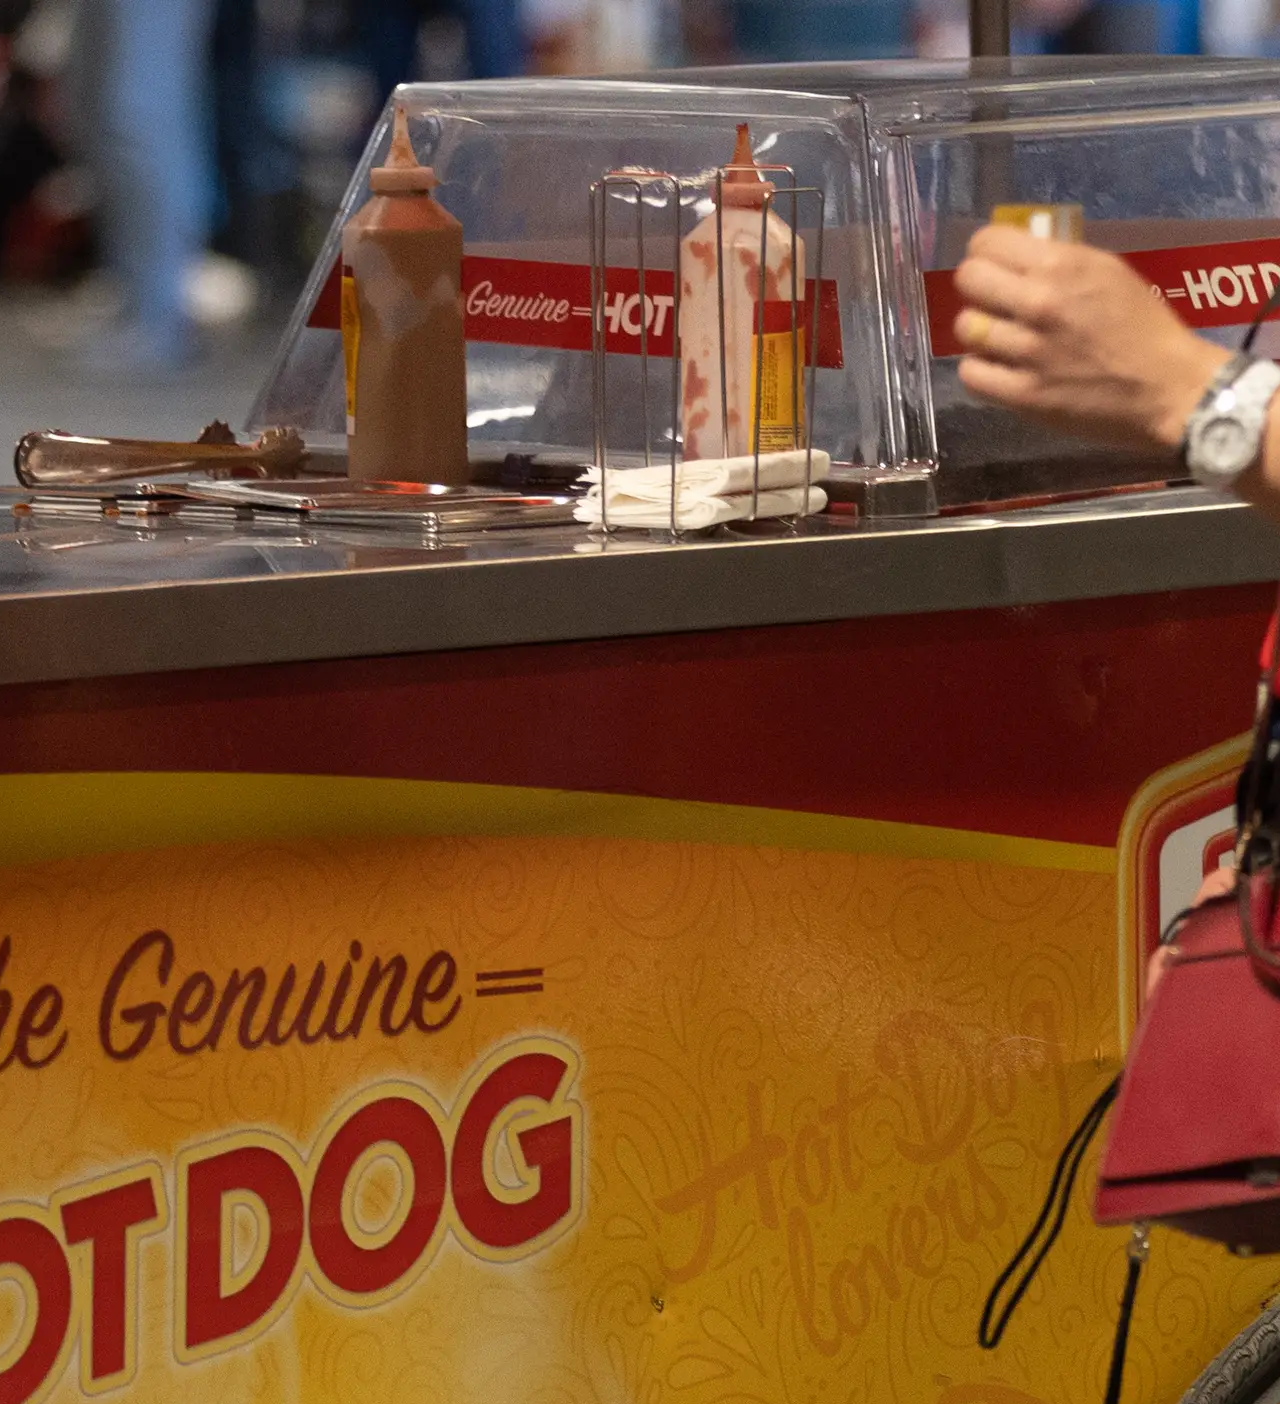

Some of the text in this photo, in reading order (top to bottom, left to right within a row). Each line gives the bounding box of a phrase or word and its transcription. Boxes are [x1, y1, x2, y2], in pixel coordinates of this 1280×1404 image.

[467, 280, 676, 337] Genuine HOT
[1182, 266, 1259, 309] HOT
[96, 929, 465, 1064] Genuine
[184, 1050, 573, 1350] DOG
[655, 1000, 1070, 1284] Hot Dog
